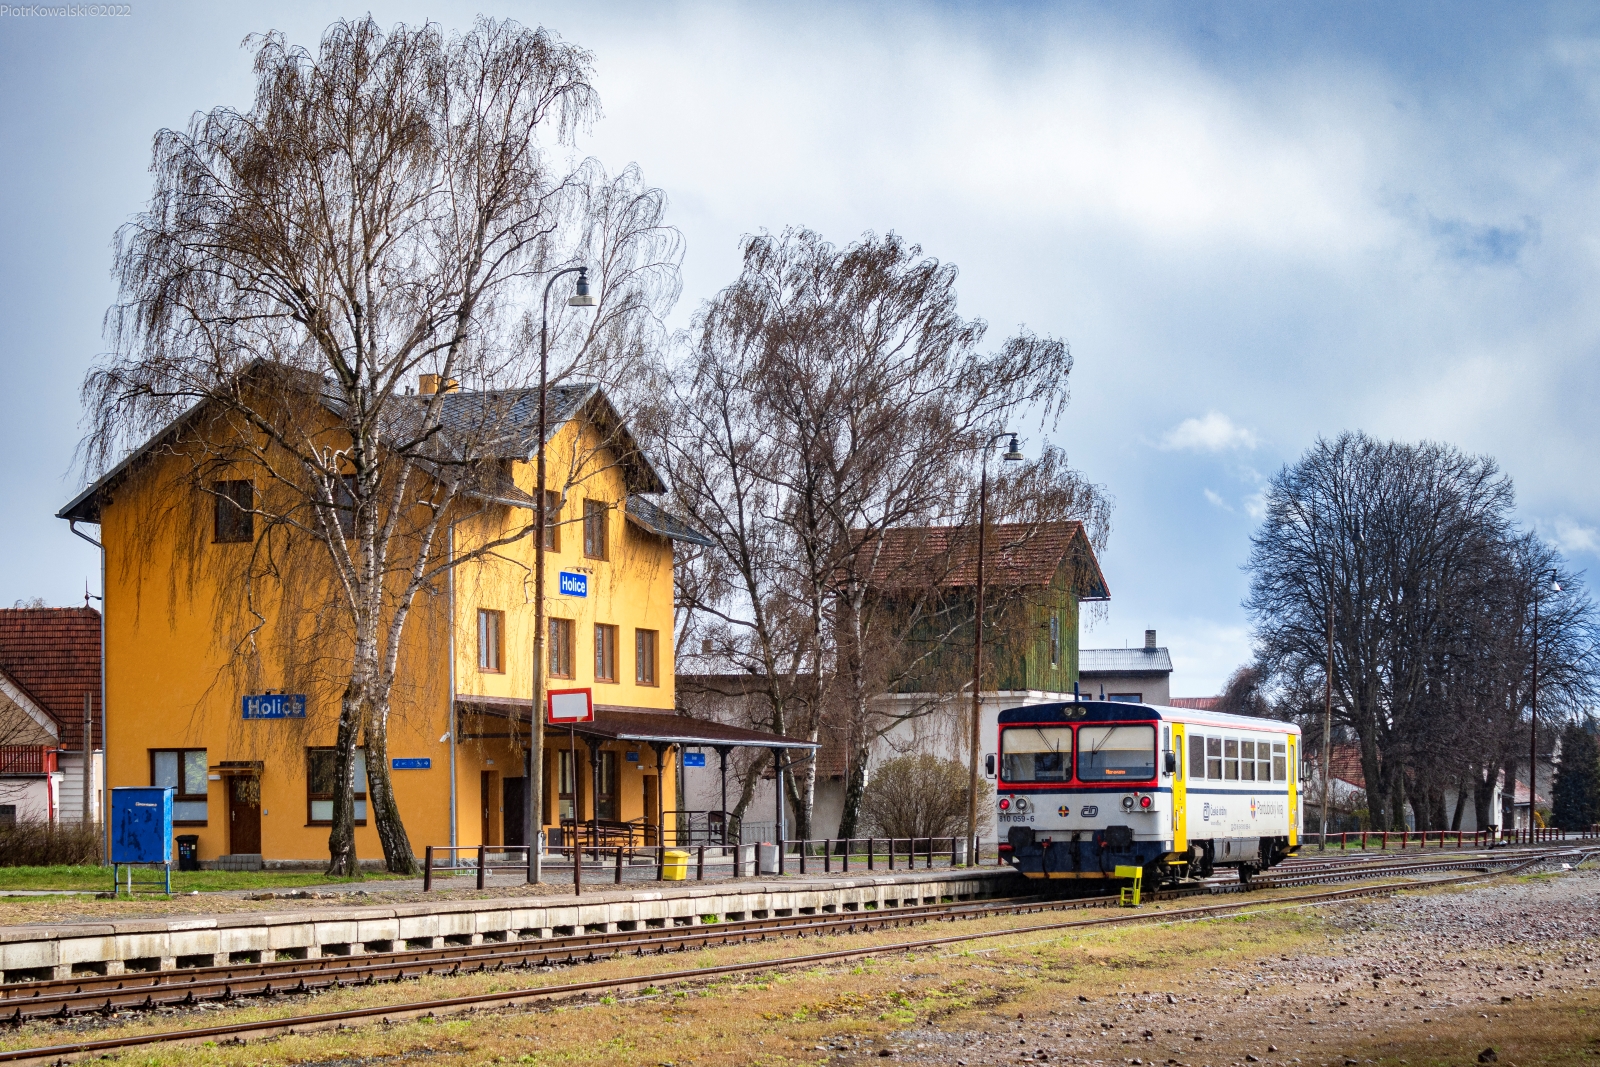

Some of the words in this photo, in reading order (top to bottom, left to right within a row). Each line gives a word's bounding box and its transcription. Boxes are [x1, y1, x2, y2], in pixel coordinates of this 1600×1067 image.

[562, 575, 586, 593] Holice
[248, 699, 302, 715] Holice
[999, 815, 1011, 823] 810
